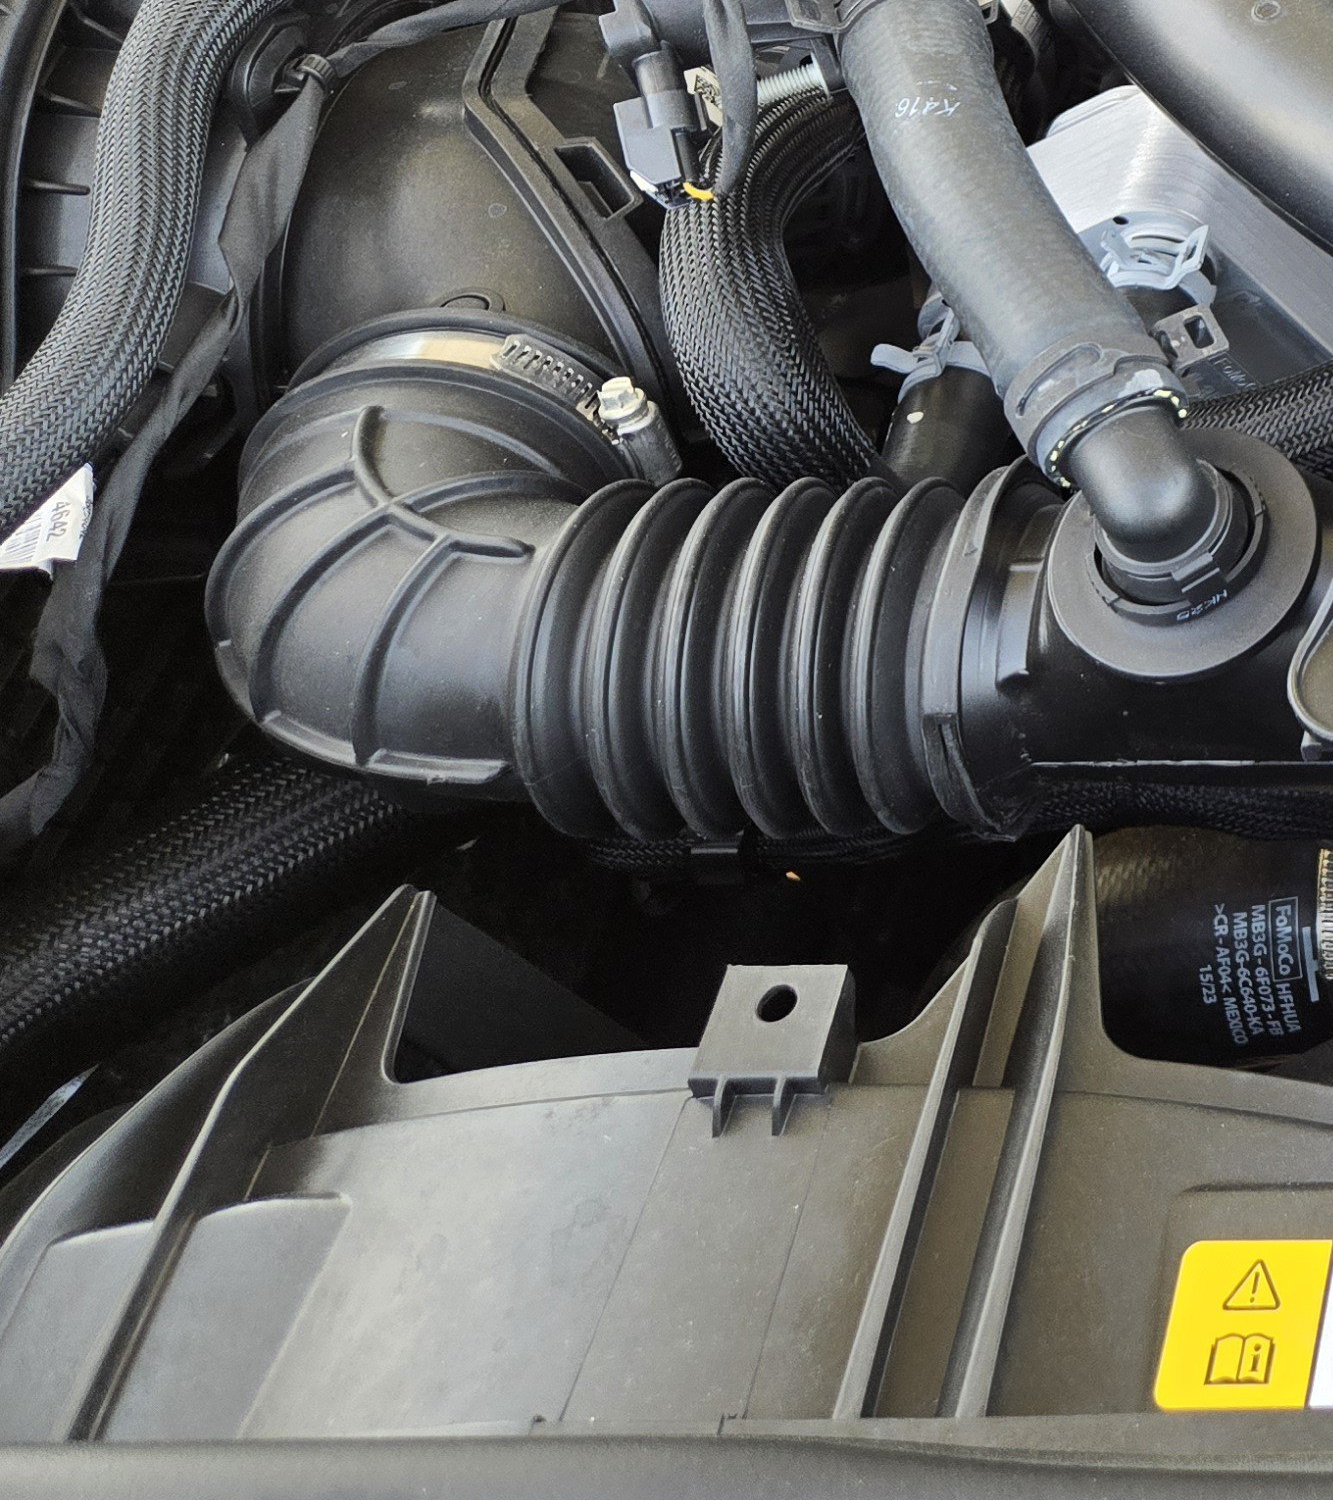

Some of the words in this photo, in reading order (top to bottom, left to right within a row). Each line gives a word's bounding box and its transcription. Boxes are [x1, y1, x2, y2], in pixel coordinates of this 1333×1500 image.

[1275, 904, 1295, 976] FoMoCo
[1199, 963, 1217, 1005] 15/23
[1276, 983, 1301, 1033] HFHUA
[1223, 996, 1249, 1045] MEXICO
